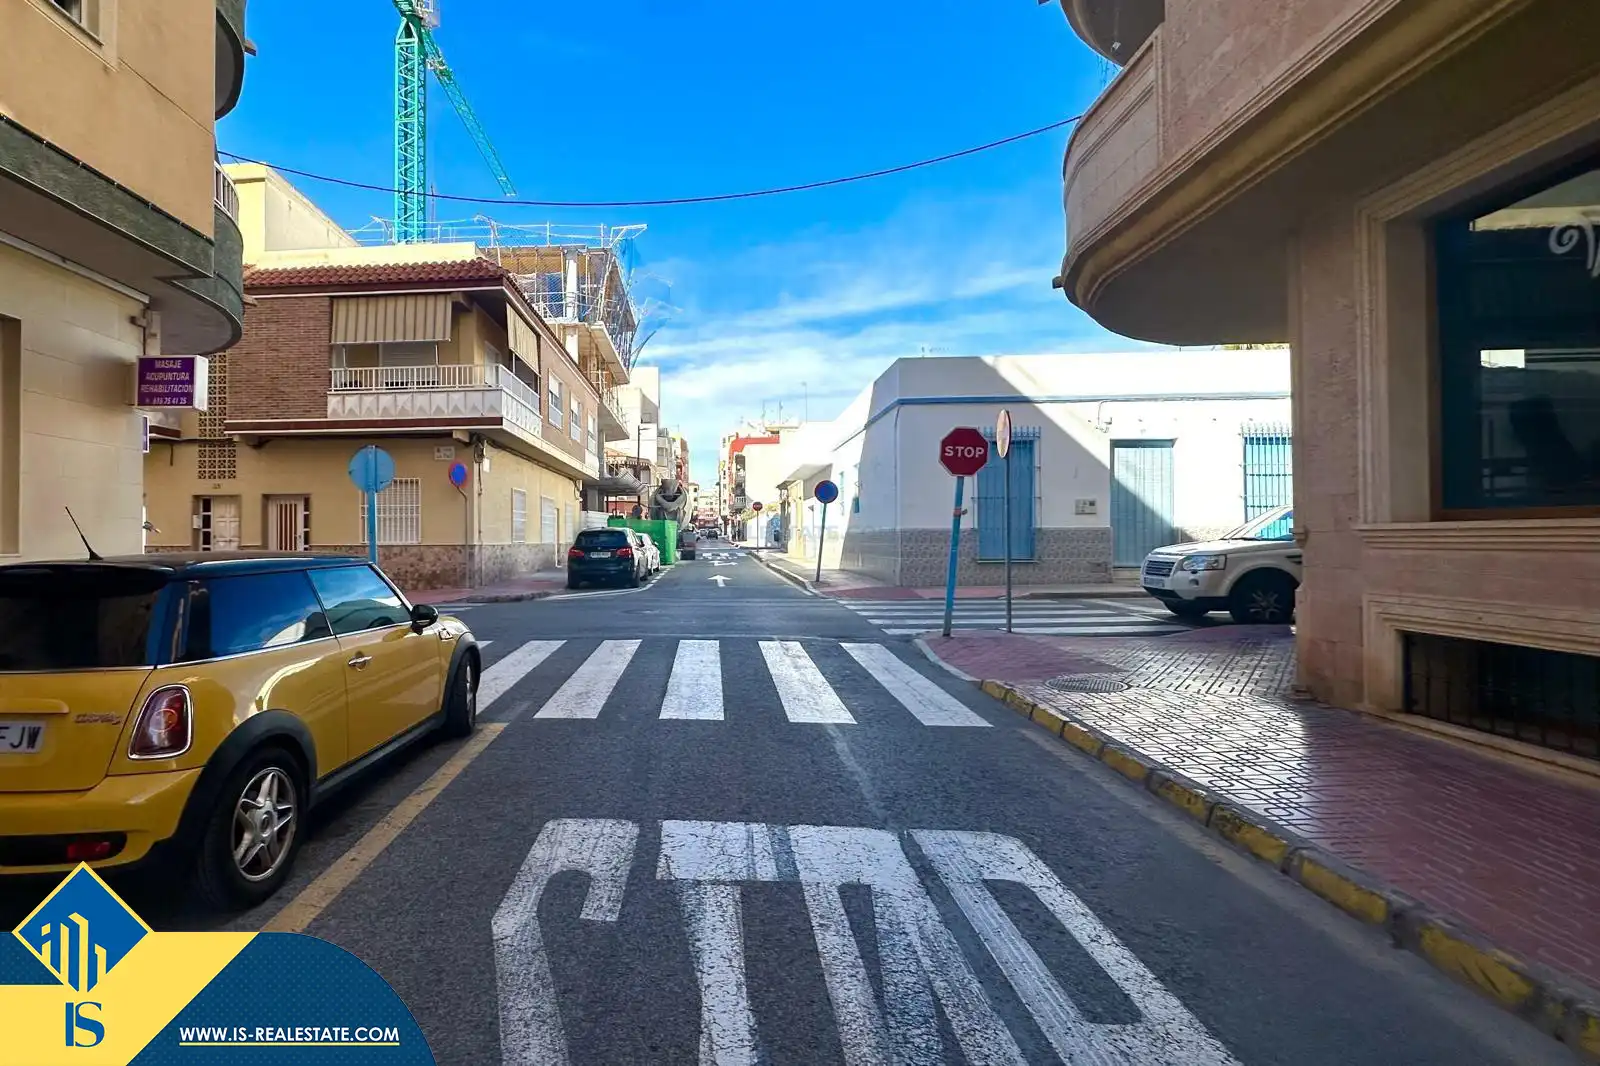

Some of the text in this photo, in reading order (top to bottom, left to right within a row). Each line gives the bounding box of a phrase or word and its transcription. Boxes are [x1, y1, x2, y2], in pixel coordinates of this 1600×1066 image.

[155, 360, 182, 369] MASAJE
[145, 371, 190, 381] ACUPUNTURA
[944, 445, 985, 458] STOP
[492, 818, 1243, 1066] STOP
